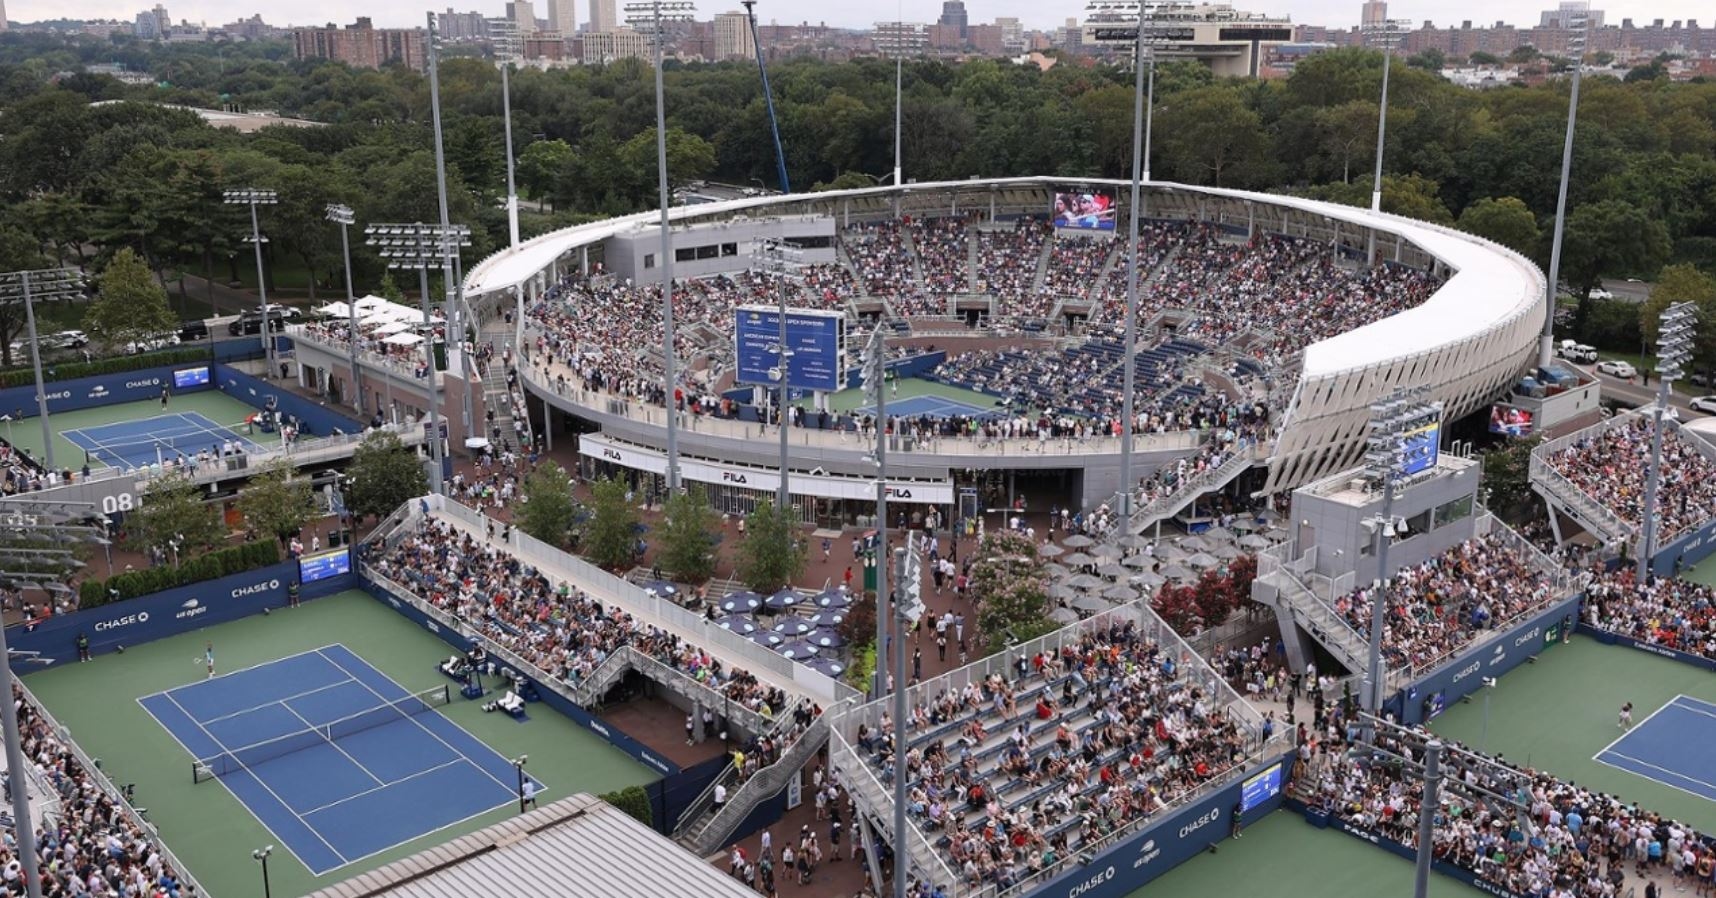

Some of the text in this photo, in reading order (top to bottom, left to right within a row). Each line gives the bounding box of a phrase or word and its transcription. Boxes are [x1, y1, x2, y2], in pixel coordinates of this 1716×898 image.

[603, 448, 622, 461] FILA
[723, 472, 747, 484] FILA
[885, 487, 912, 499] FILA
[102, 492, 133, 514] 08
[231, 581, 269, 598] CHASE
[94, 614, 137, 632] CHASE
[1179, 814, 1210, 839] CHASE
[1069, 872, 1105, 898] CHASE
